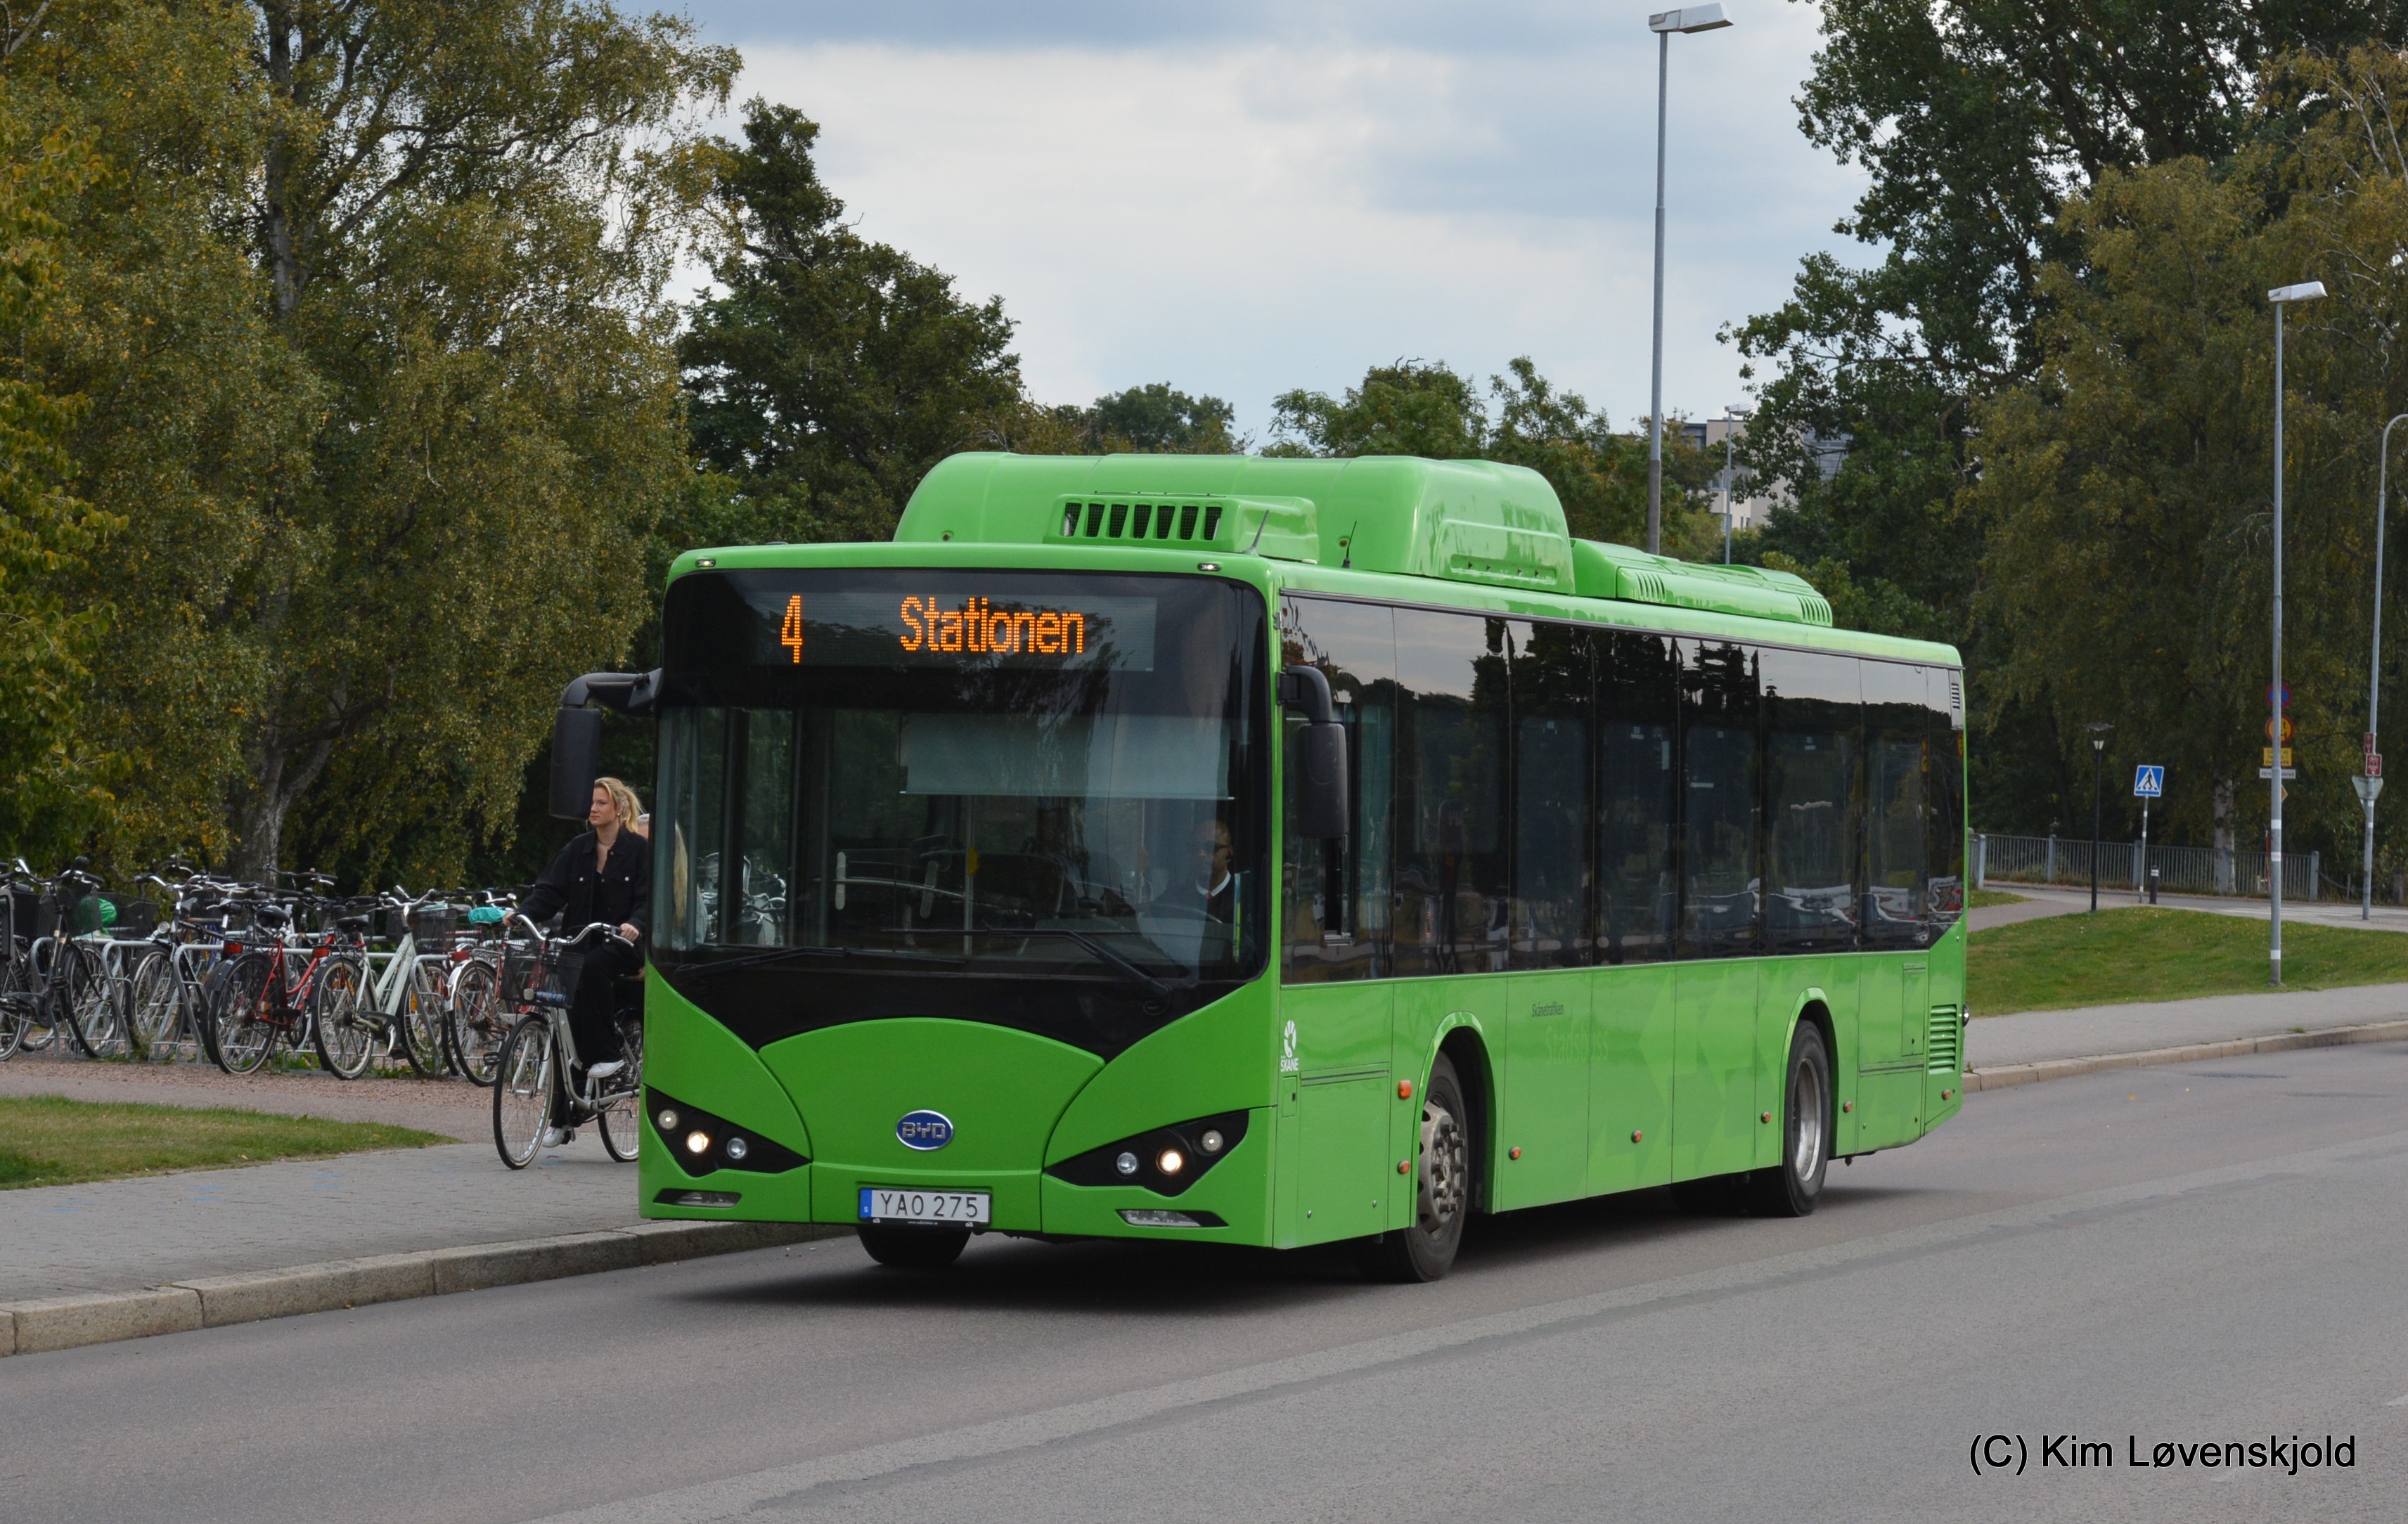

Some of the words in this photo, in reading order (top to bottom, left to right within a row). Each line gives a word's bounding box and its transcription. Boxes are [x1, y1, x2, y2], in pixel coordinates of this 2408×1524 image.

[781, 595, 803, 664] 4
[901, 596, 1084, 654] Stationen
[901, 1122, 946, 1139] BYD
[880, 1193, 925, 1216] YAO
[933, 1195, 978, 1218] 275
